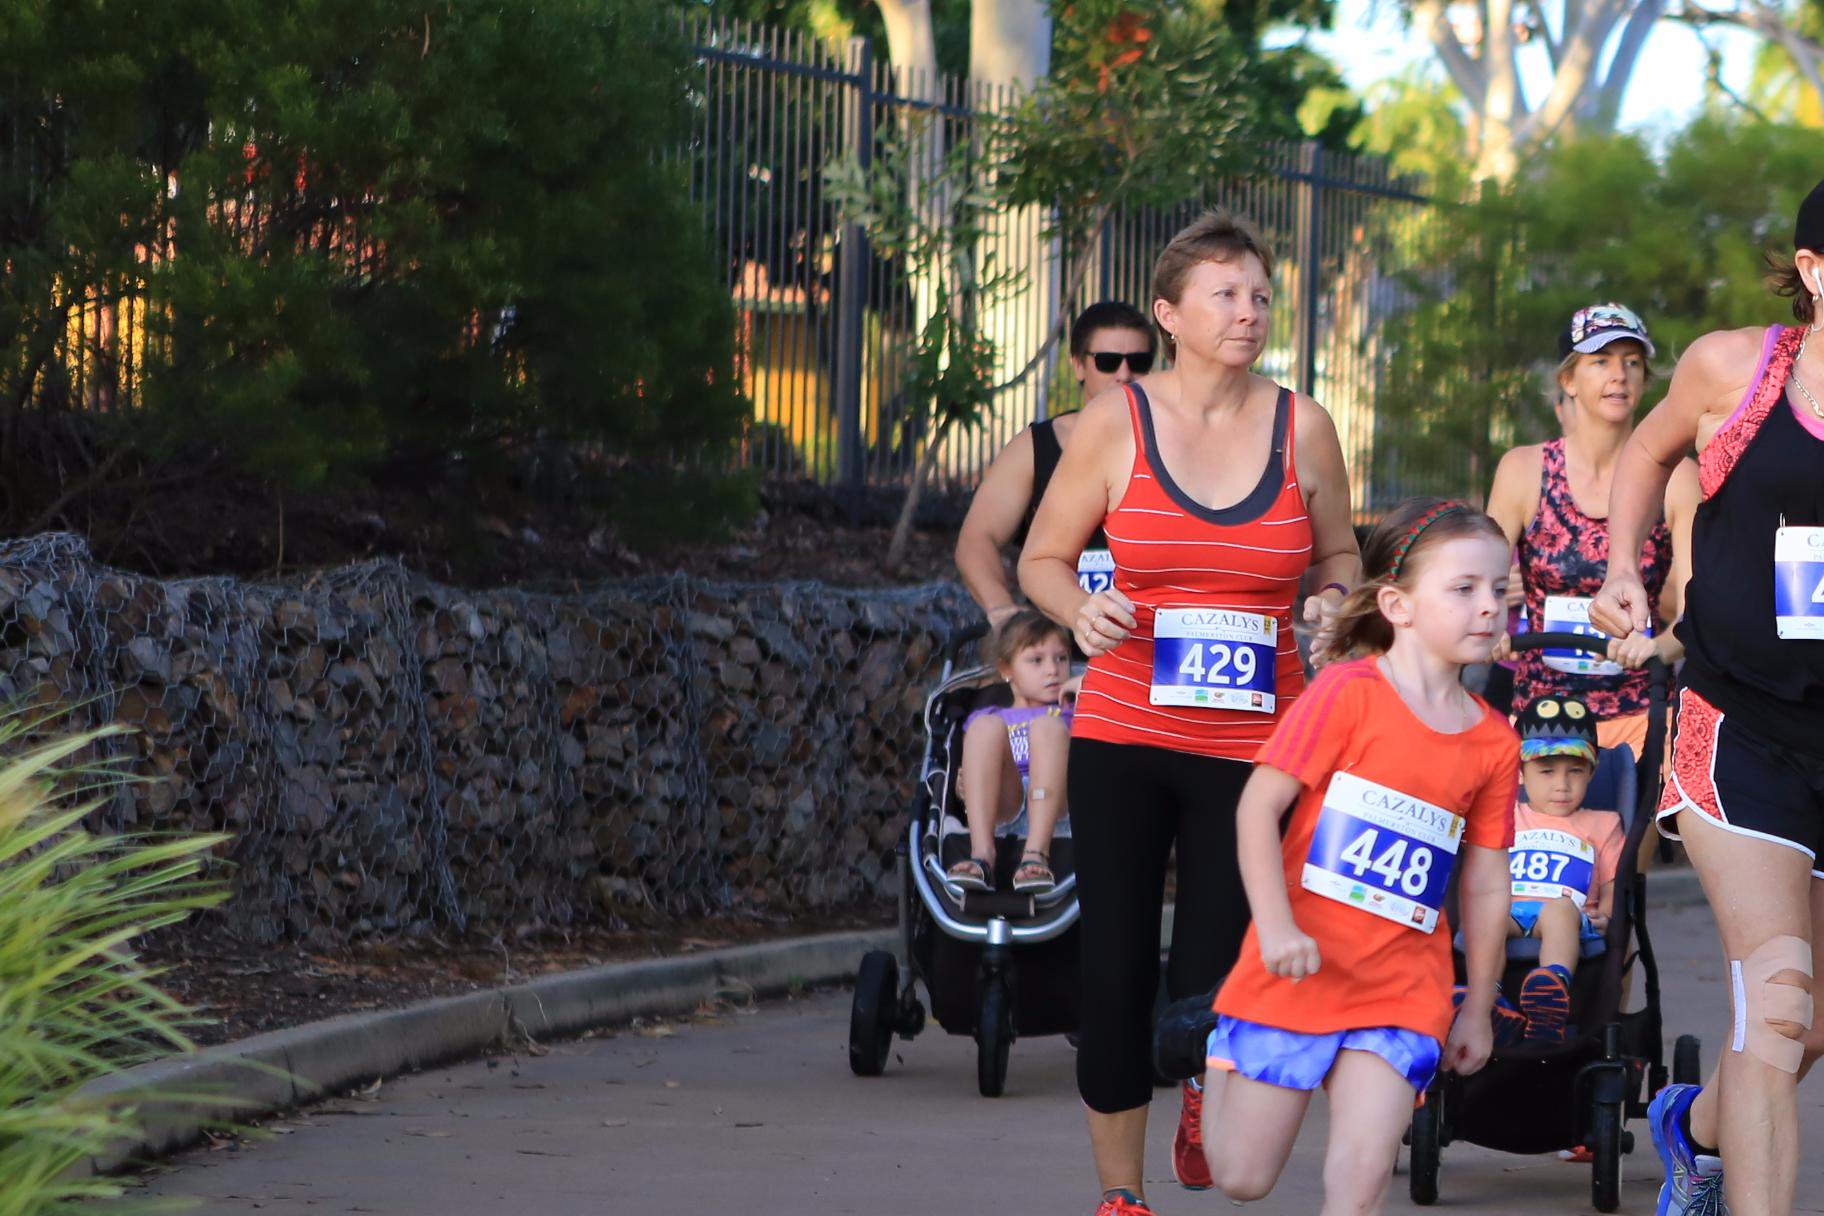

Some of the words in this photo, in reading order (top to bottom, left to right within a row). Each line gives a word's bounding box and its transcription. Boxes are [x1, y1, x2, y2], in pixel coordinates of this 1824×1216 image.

[1181, 613, 1259, 631] CAZALYS
[1179, 643, 1256, 686] 429
[1362, 790, 1448, 832] CAZALYS
[1521, 831, 1576, 848] AZALYS
[1340, 828, 1433, 897] 448
[1510, 851, 1570, 882] 487
